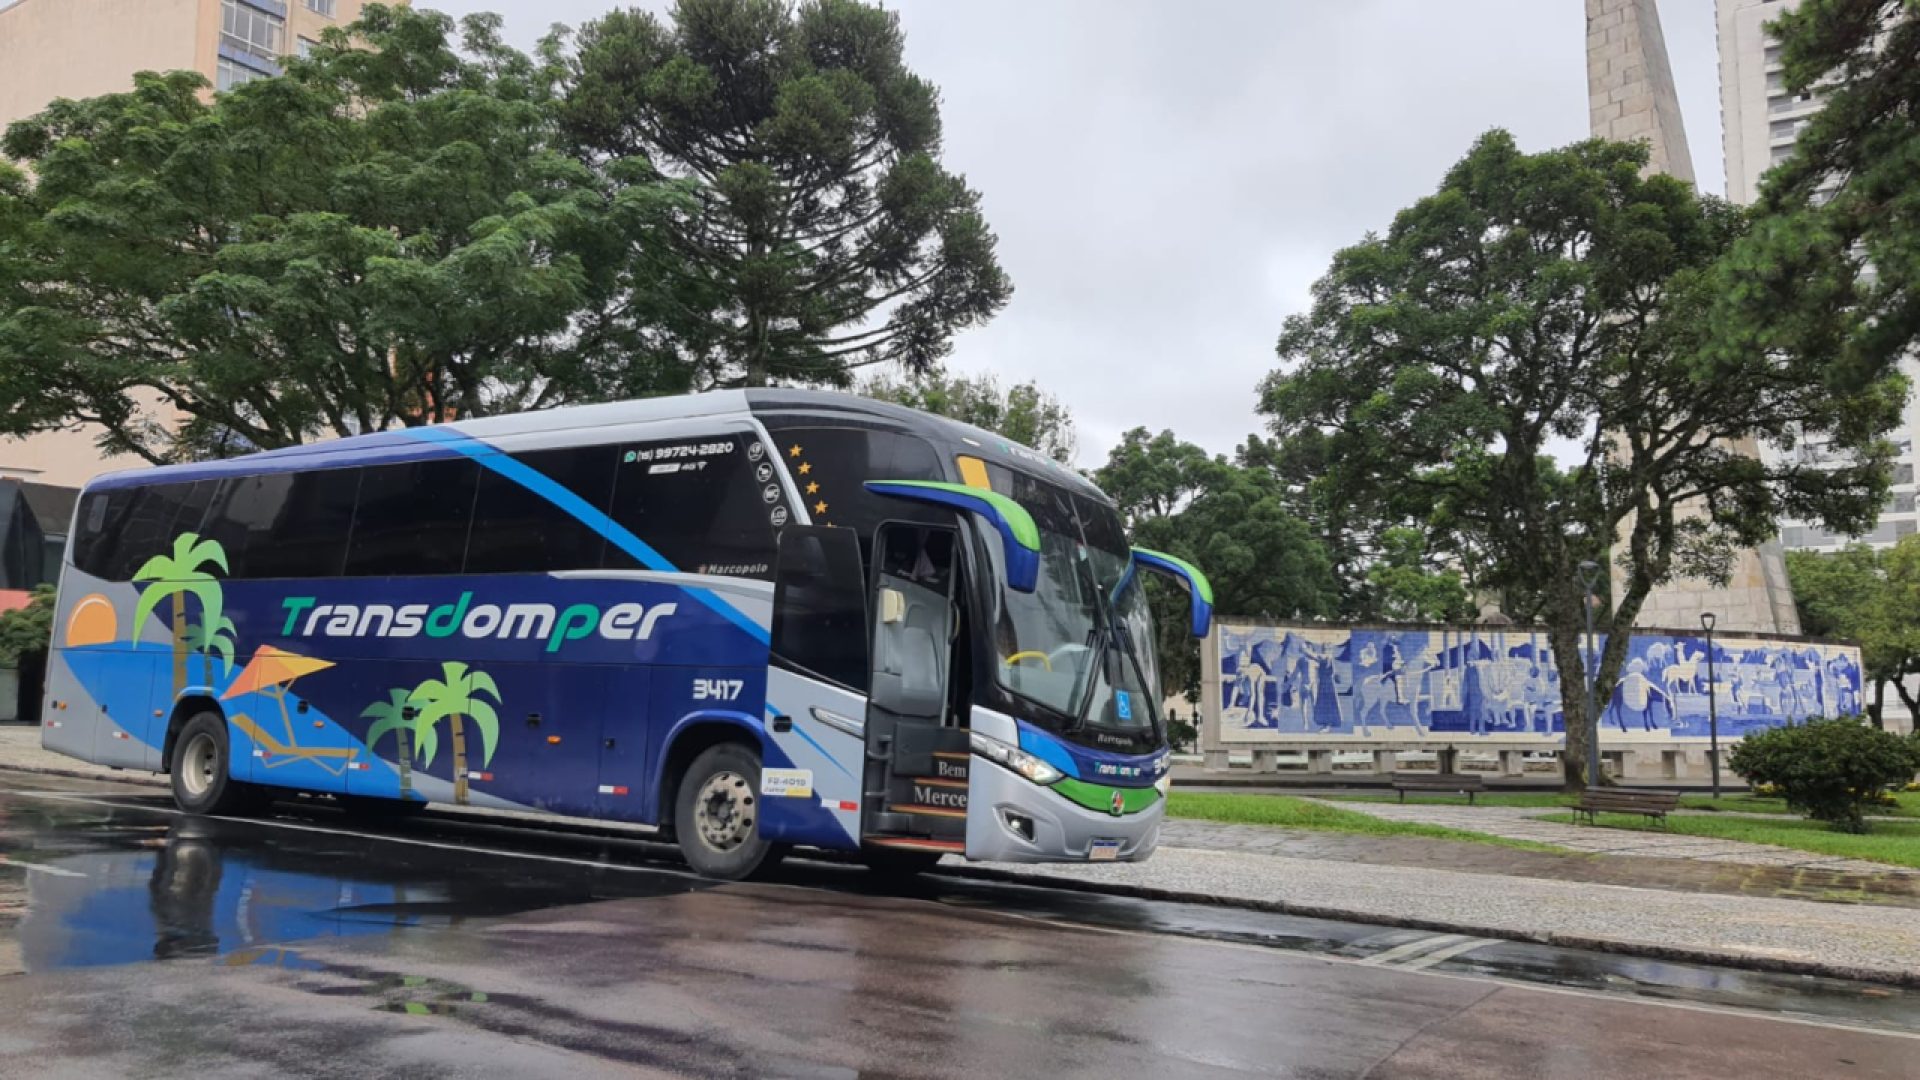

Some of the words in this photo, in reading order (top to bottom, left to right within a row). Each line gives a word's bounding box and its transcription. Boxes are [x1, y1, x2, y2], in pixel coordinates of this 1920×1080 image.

[707, 563, 769, 575] Marcopolo
[281, 591, 678, 652] Transdomper
[692, 678, 744, 700] 3417
[938, 761, 967, 777] Bem
[913, 785, 967, 807] Merce
